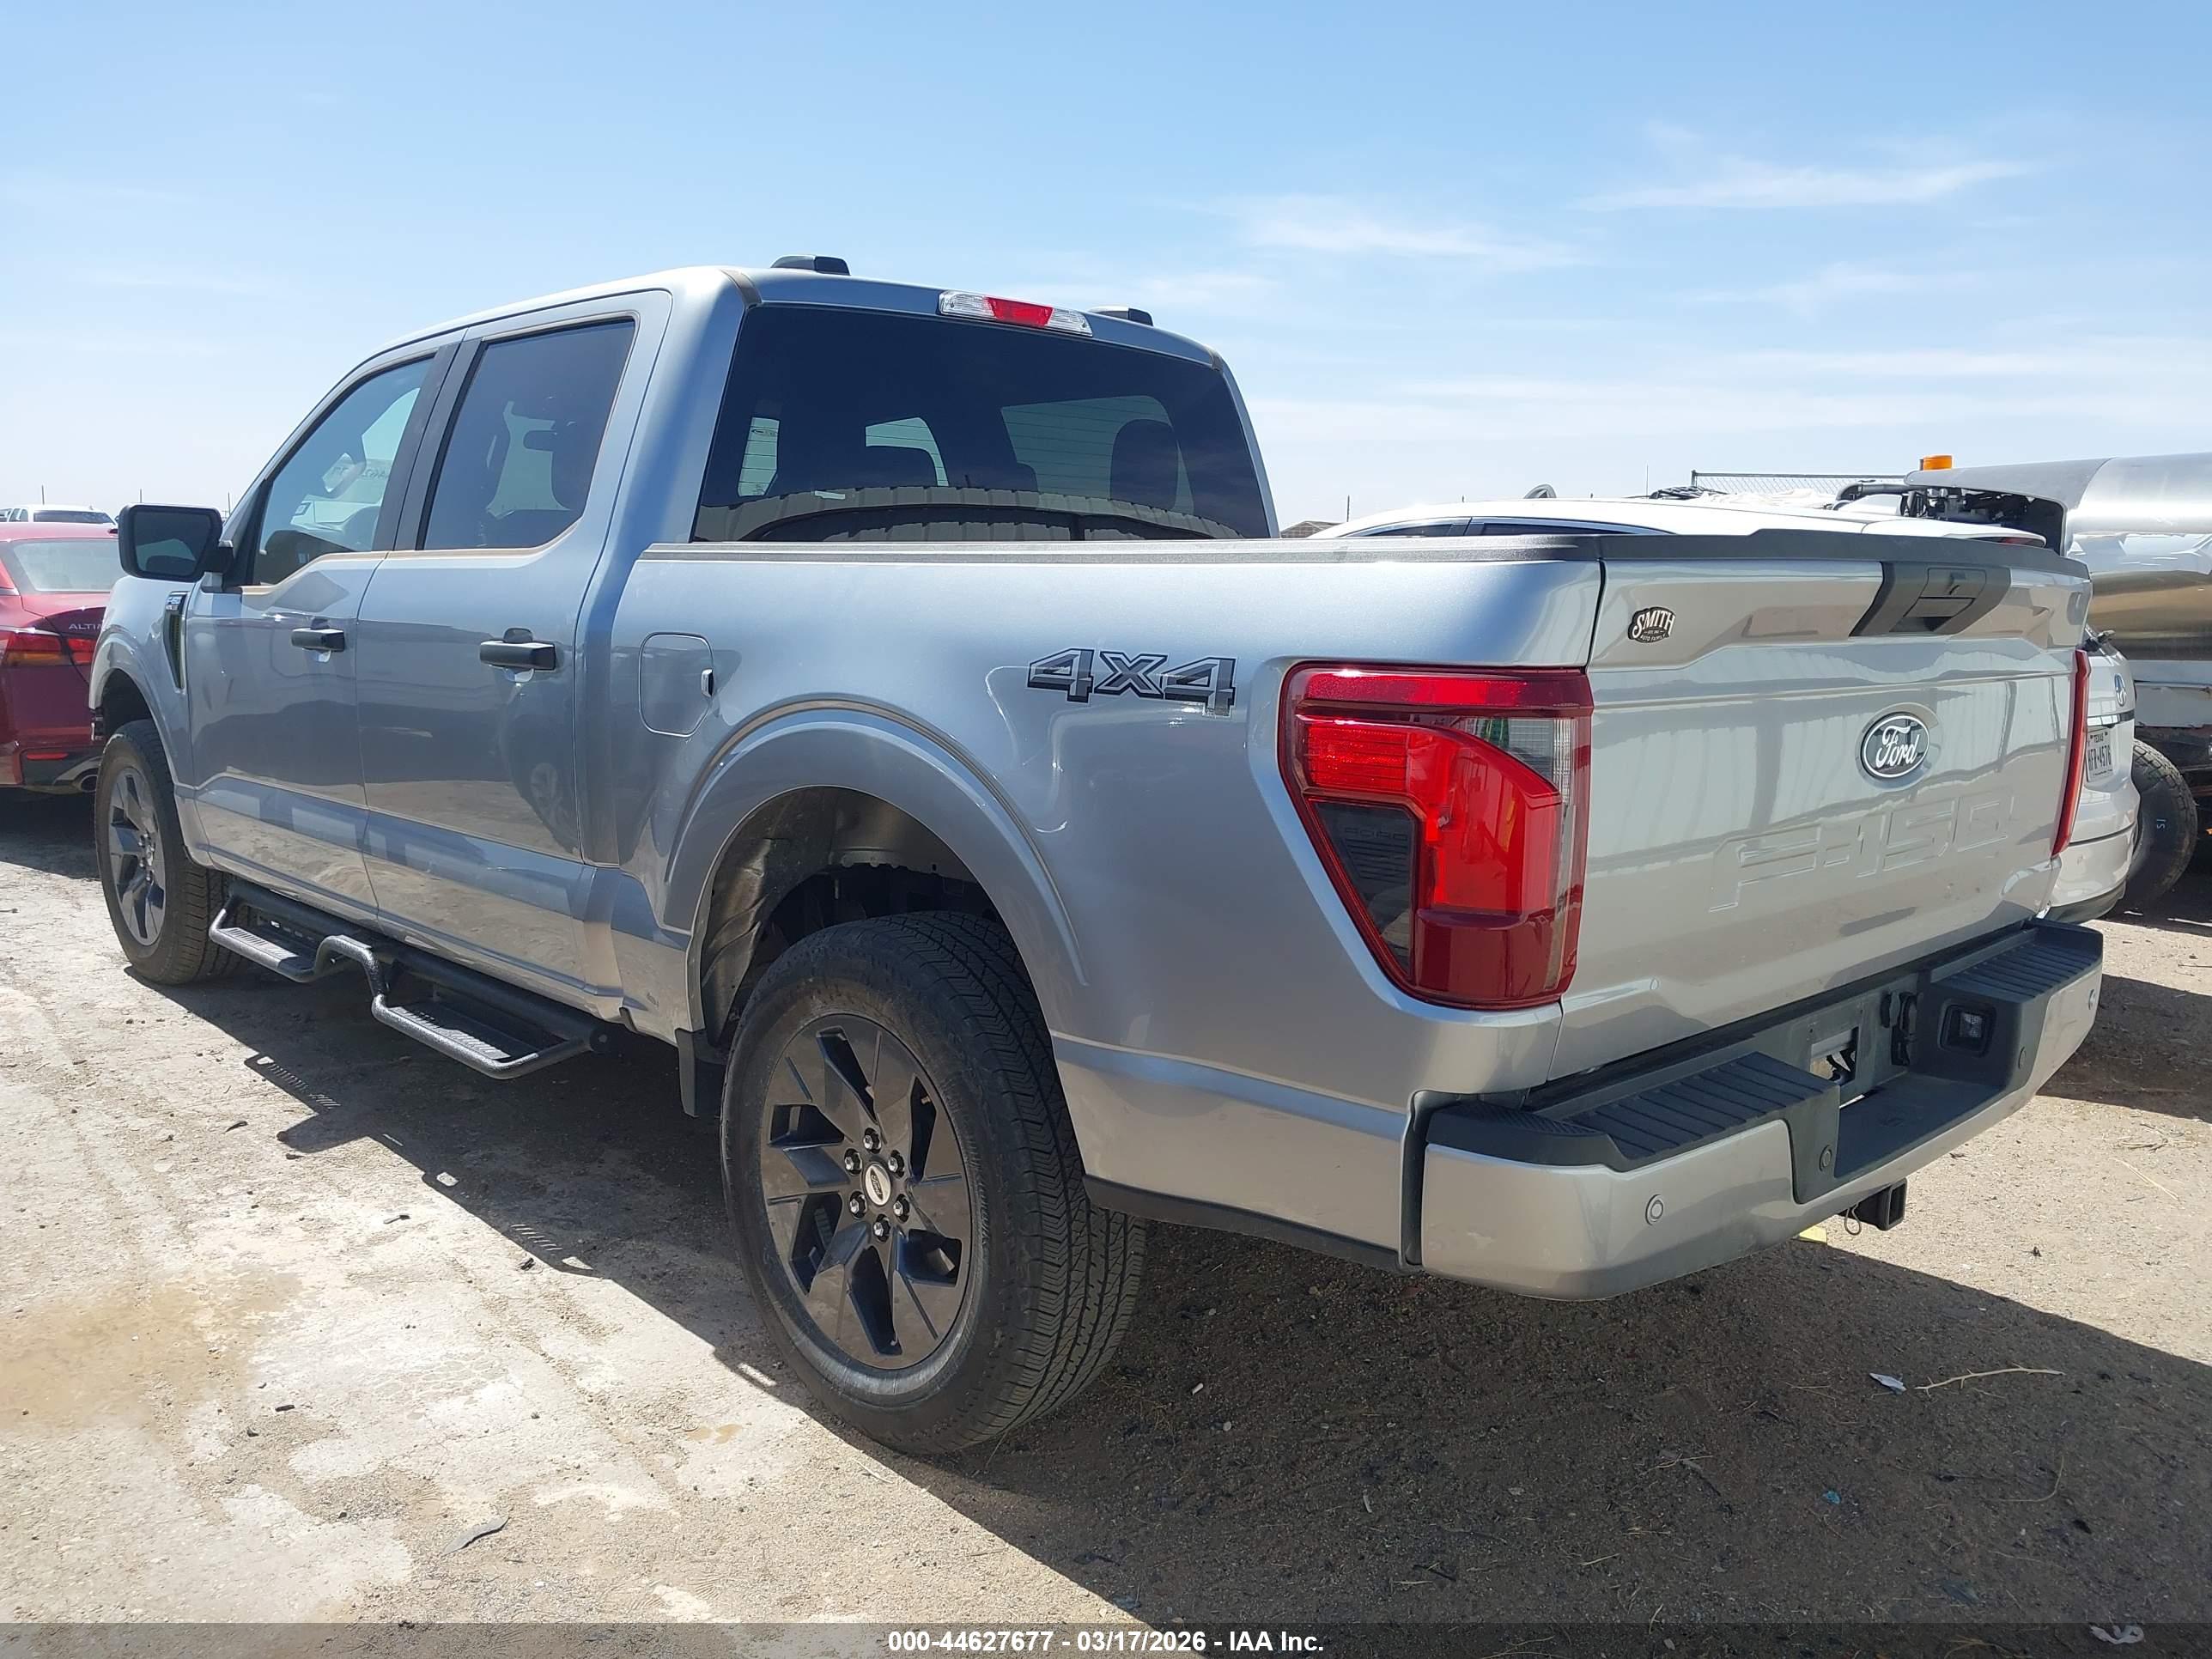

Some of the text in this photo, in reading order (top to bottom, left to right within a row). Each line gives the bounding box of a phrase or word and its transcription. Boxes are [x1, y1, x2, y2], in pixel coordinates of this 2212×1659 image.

[1632, 610, 1675, 638] SMITH
[1028, 648, 1236, 716] 4X4
[1875, 725, 1921, 768] Ford
